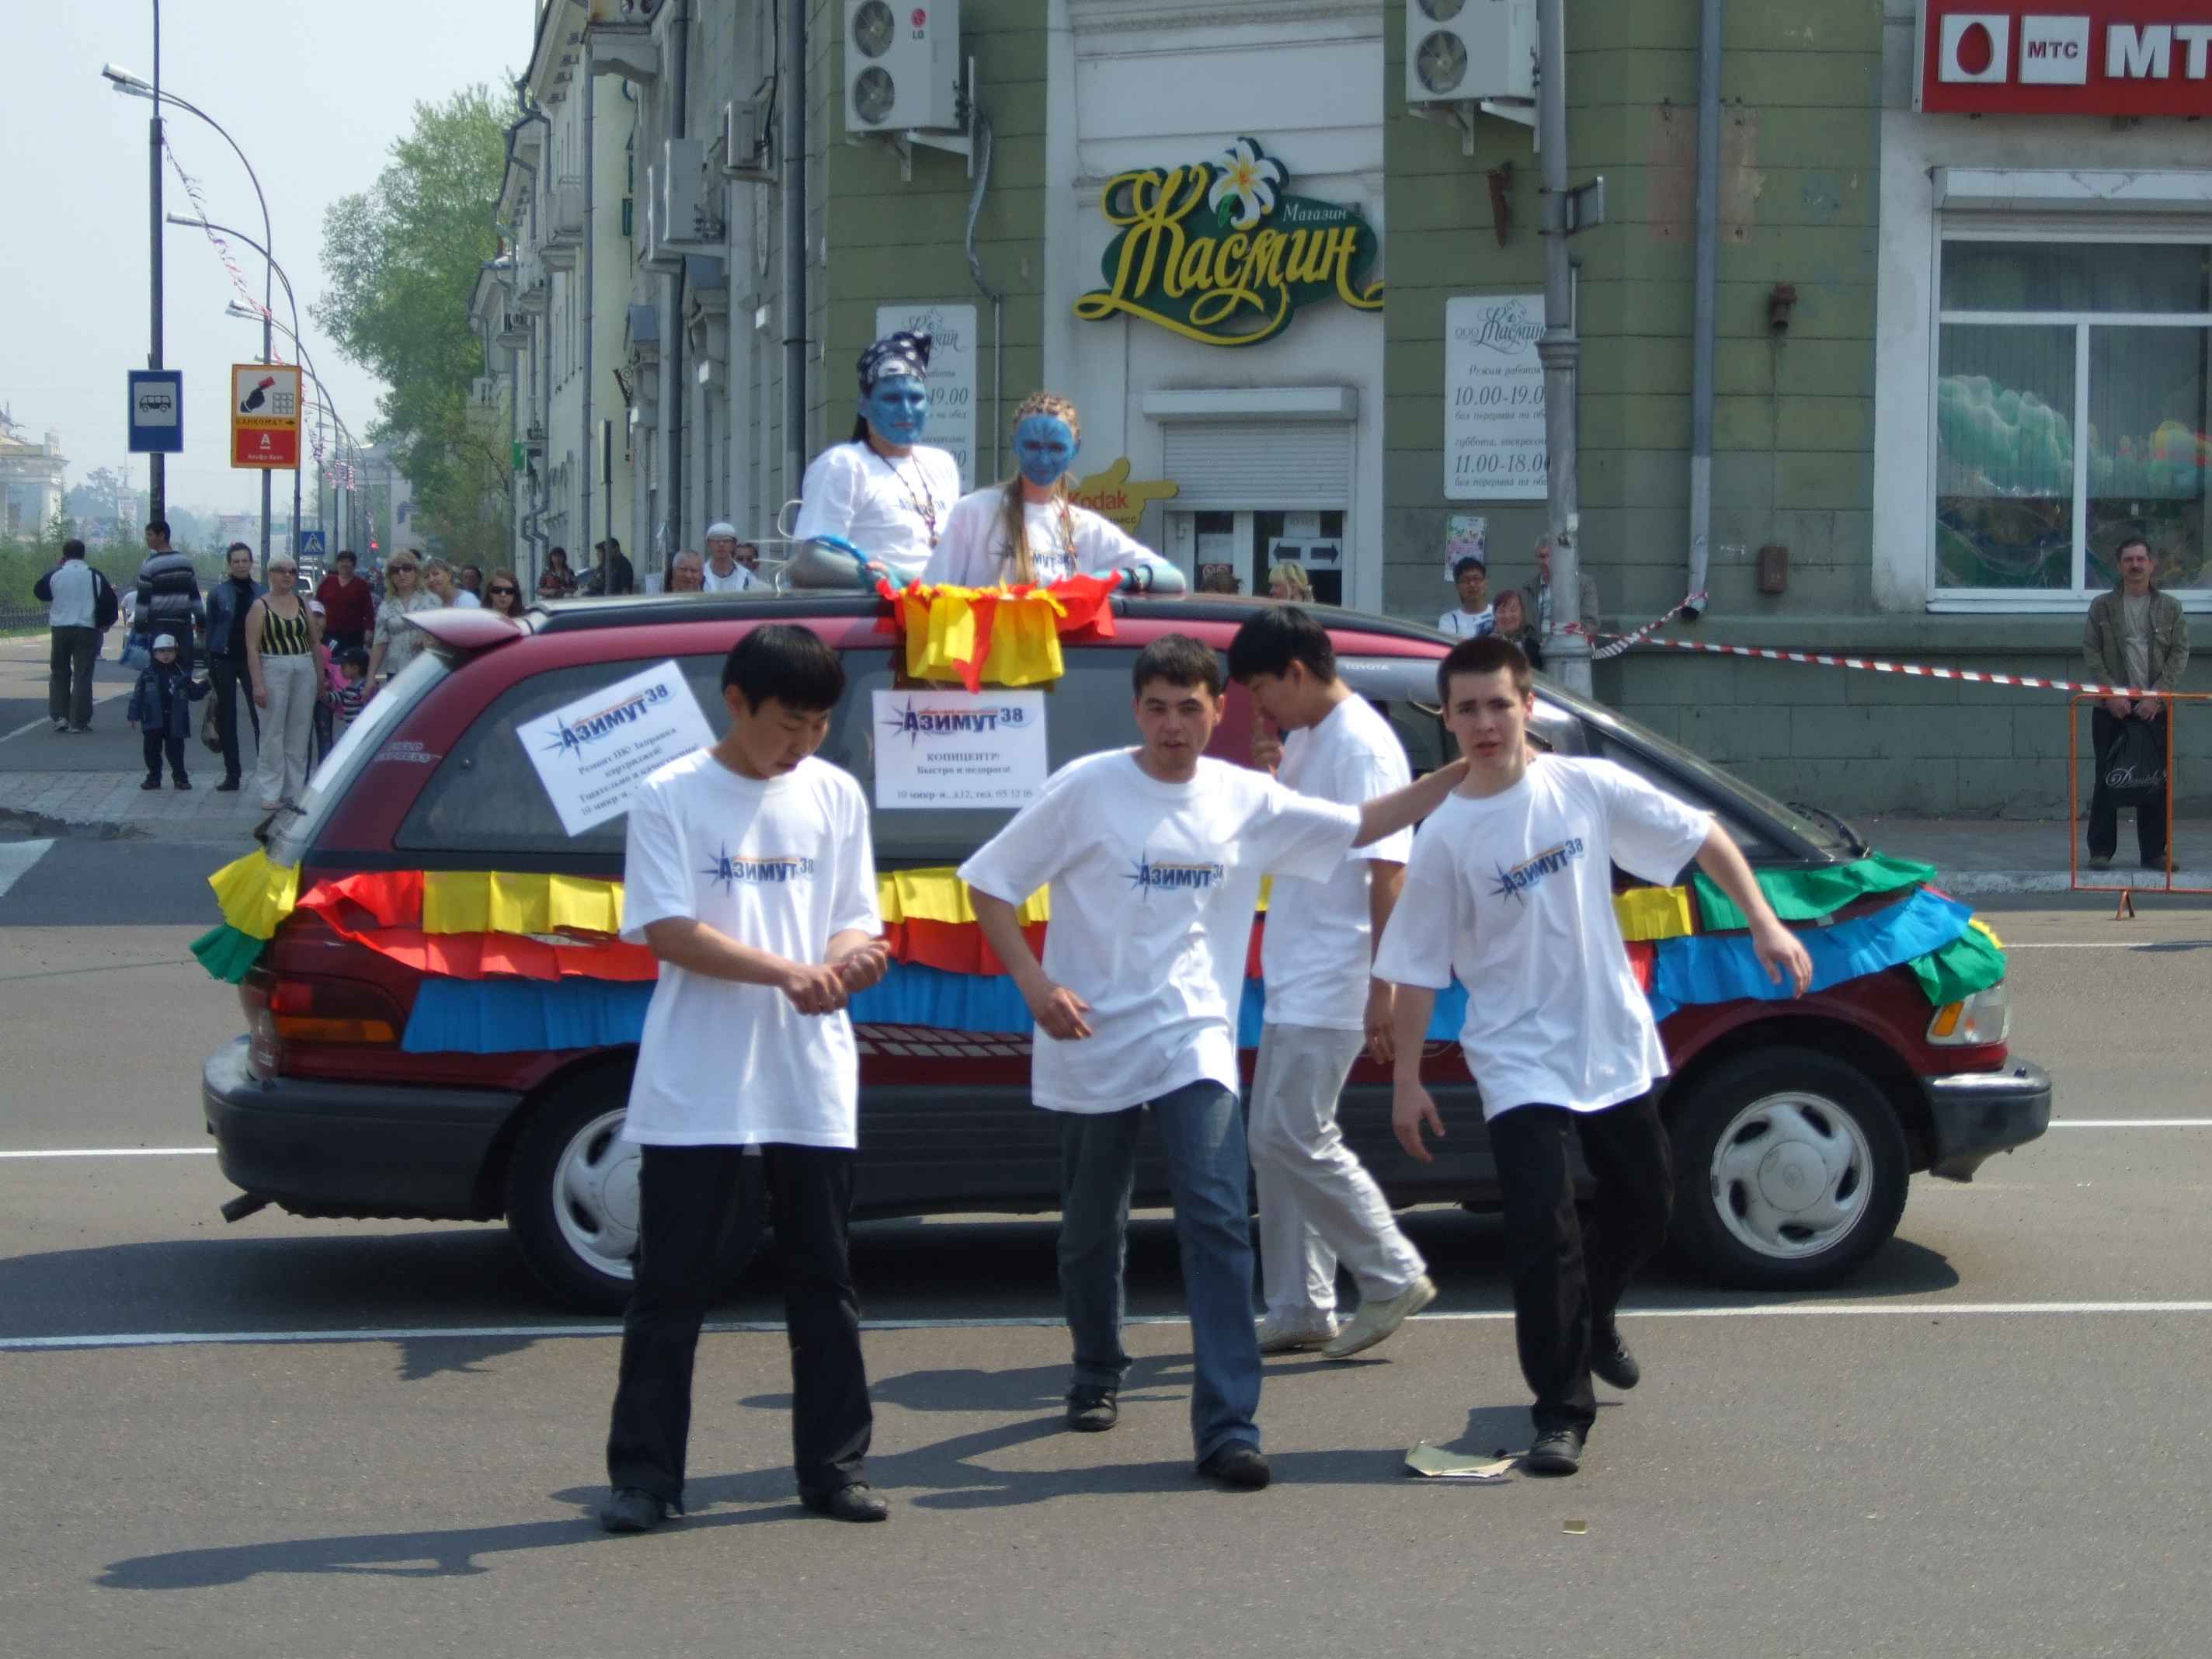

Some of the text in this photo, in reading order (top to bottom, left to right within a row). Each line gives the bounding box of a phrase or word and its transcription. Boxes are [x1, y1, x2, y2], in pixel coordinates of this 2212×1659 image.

[911, 30, 924, 39] LG
[2027, 41, 2078, 59] МТС
[1282, 203, 1348, 223] Магазин
[1073, 163, 1384, 346] Жасмин
[1456, 385, 1546, 405] 10.00-19.0
[1068, 490, 1130, 510] Kodak
